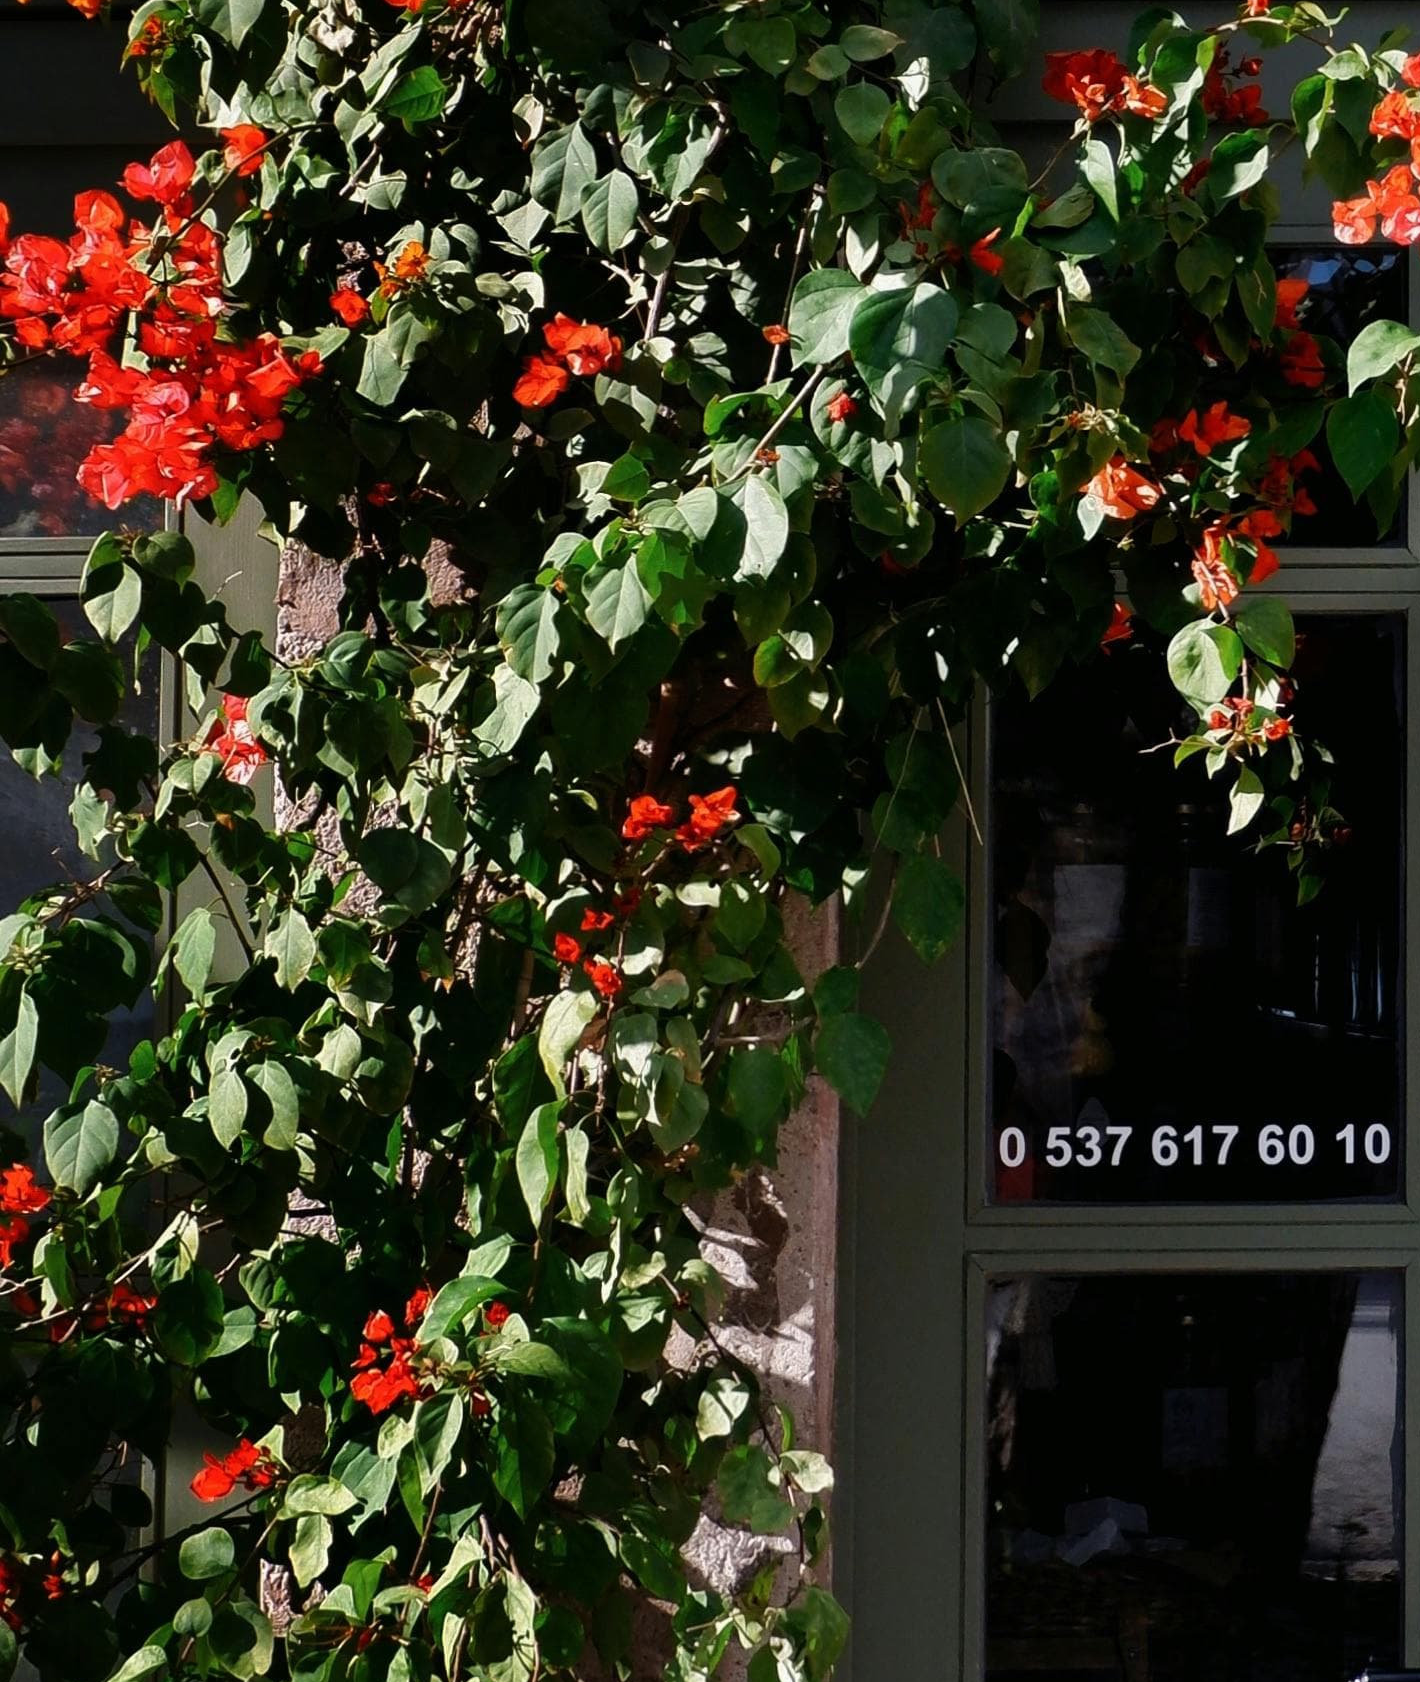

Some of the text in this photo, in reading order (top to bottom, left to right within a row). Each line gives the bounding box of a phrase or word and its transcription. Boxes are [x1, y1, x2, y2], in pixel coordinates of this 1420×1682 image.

[999, 1123, 1392, 1168] 0 537 617 60 10
